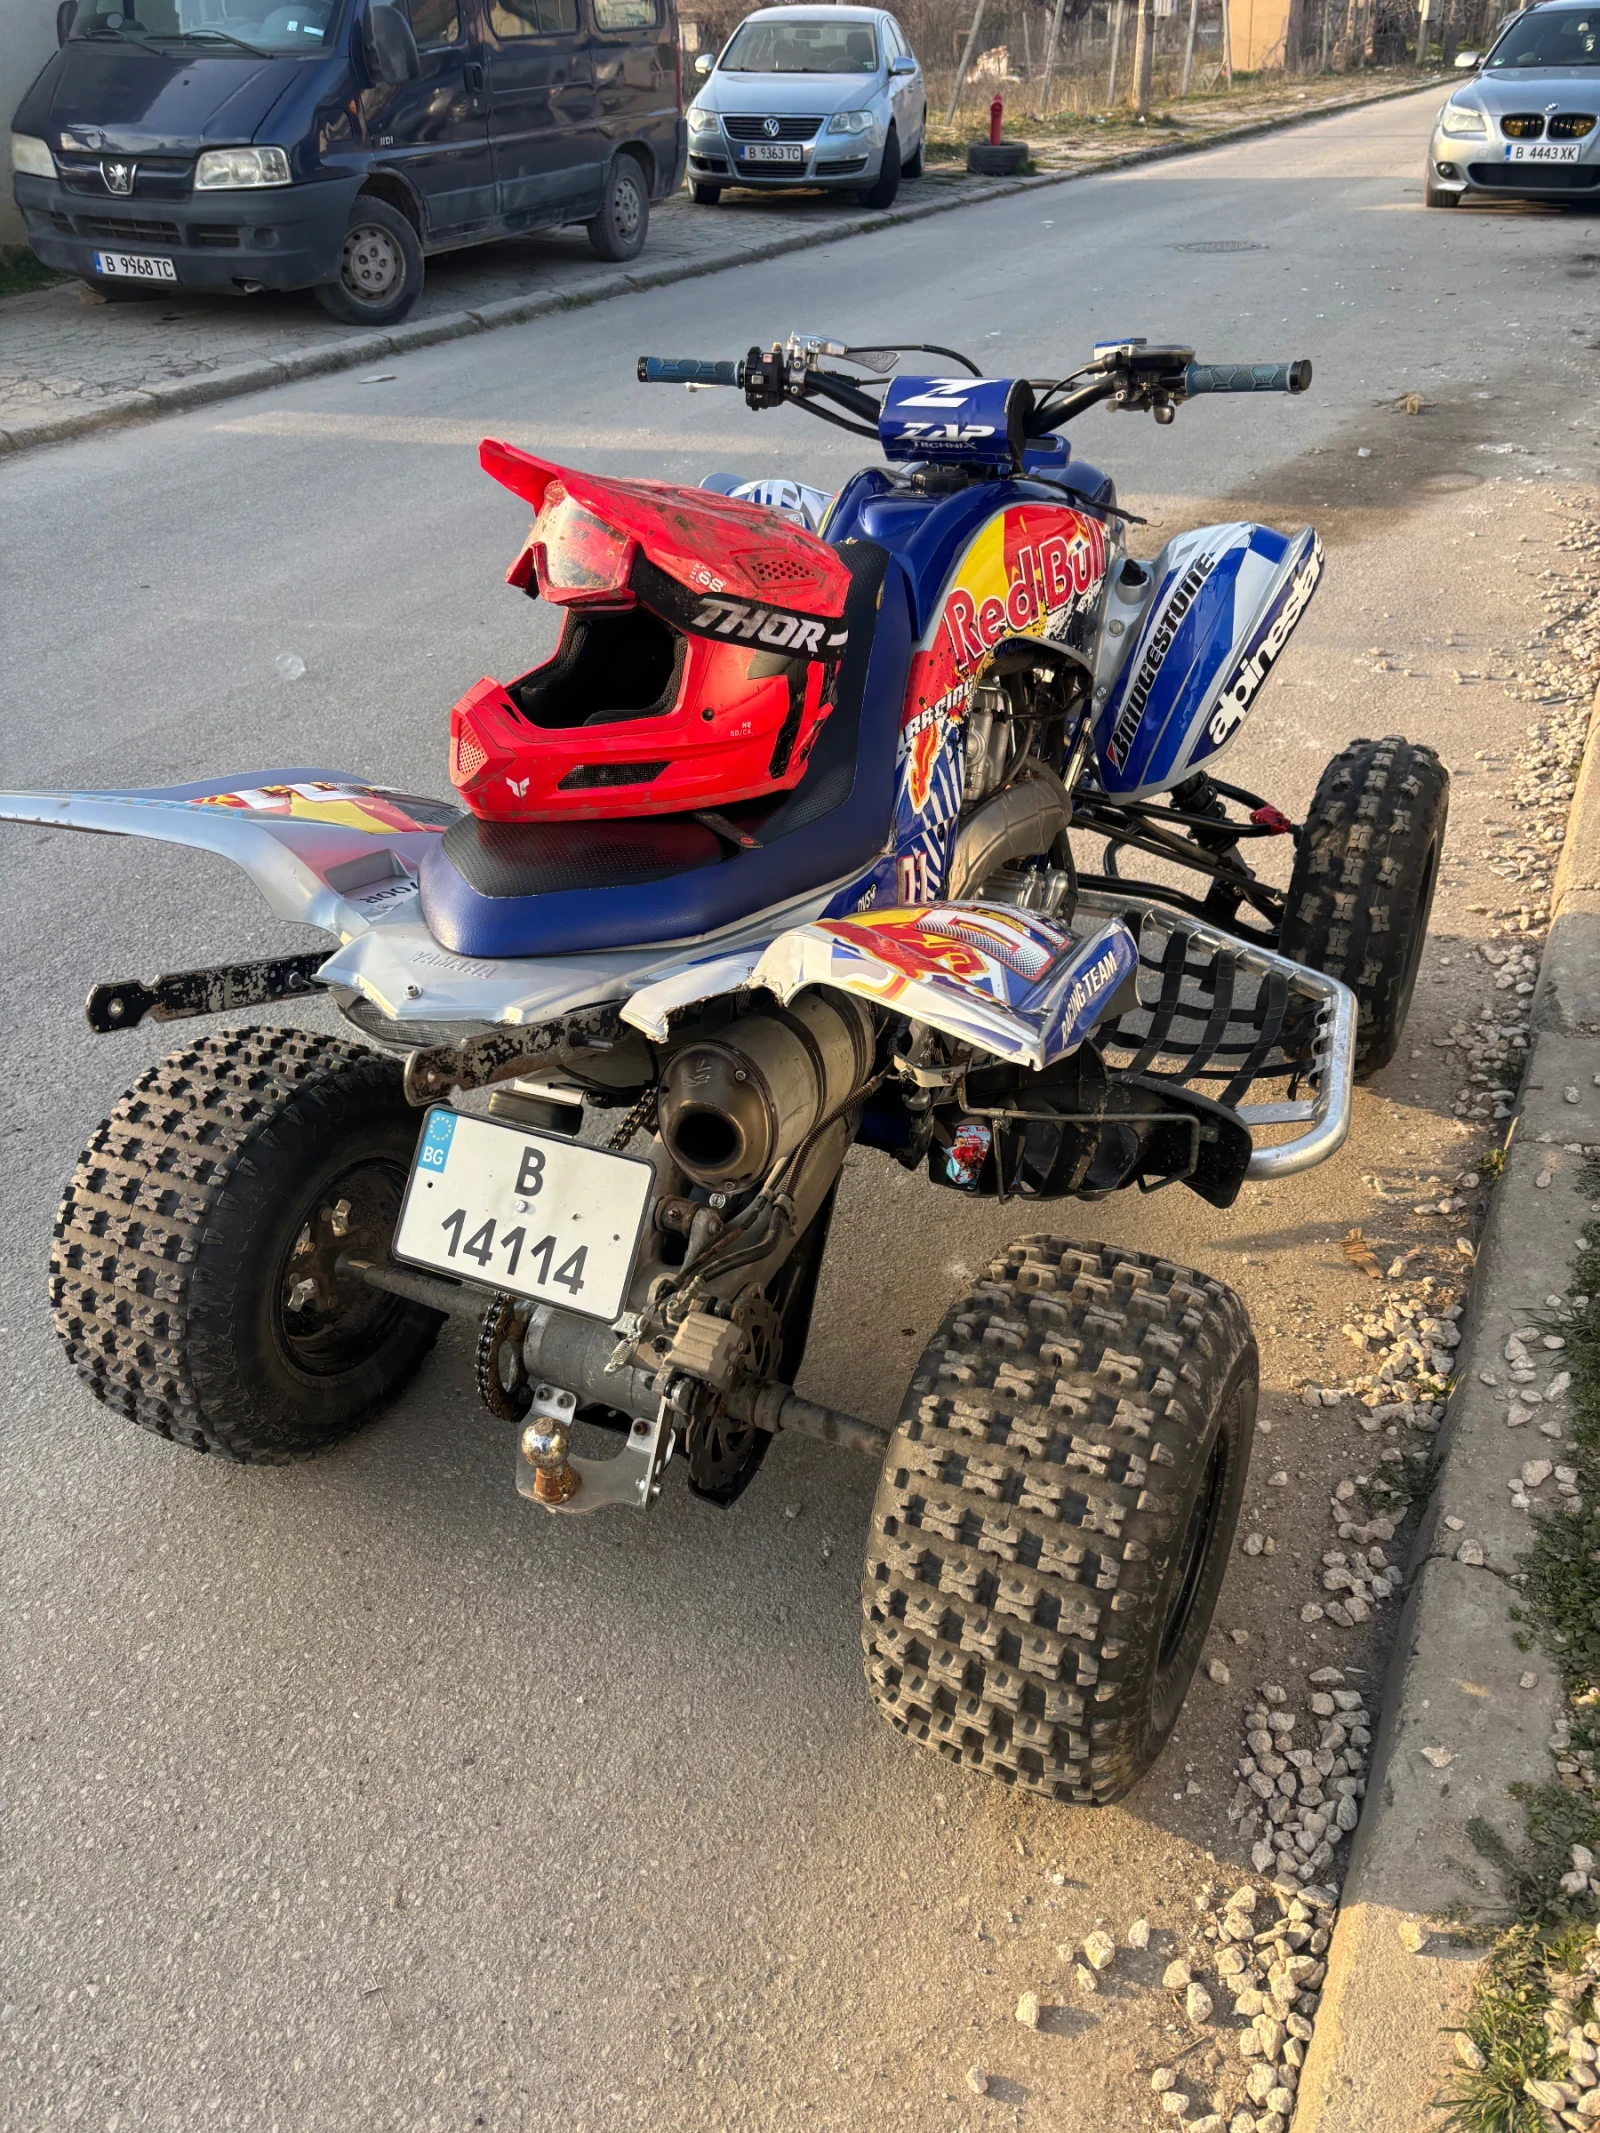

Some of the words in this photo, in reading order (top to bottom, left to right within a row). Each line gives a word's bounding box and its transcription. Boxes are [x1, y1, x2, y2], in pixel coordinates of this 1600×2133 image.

[749, 147, 756, 159] B
[760, 147, 784, 160] 9363
[786, 148, 799, 160] TC
[1516, 147, 1524, 159] B
[1530, 147, 1558, 160] 4443
[1560, 147, 1576, 160] XK
[105, 255, 116, 272] B
[120, 257, 153, 276] 9968
[153, 260, 173, 277] TC
[894, 422, 996, 442] ZAP
[911, 440, 978, 450] TECHNIX
[943, 546, 1041, 671] Red
[1039, 514, 1107, 614] Bull
[691, 598, 827, 653] THOR
[1209, 529, 1324, 745] alpinestars
[1106, 551, 1216, 776] BRIDGESTONE
[408, 950, 499, 979] YAMAHA
[1061, 982, 1087, 1050] RACING
[1081, 950, 1118, 998] TEAM
[422, 1146, 444, 1166] BG
[514, 1146, 547, 1197] B
[441, 1208, 589, 1296] 14114
